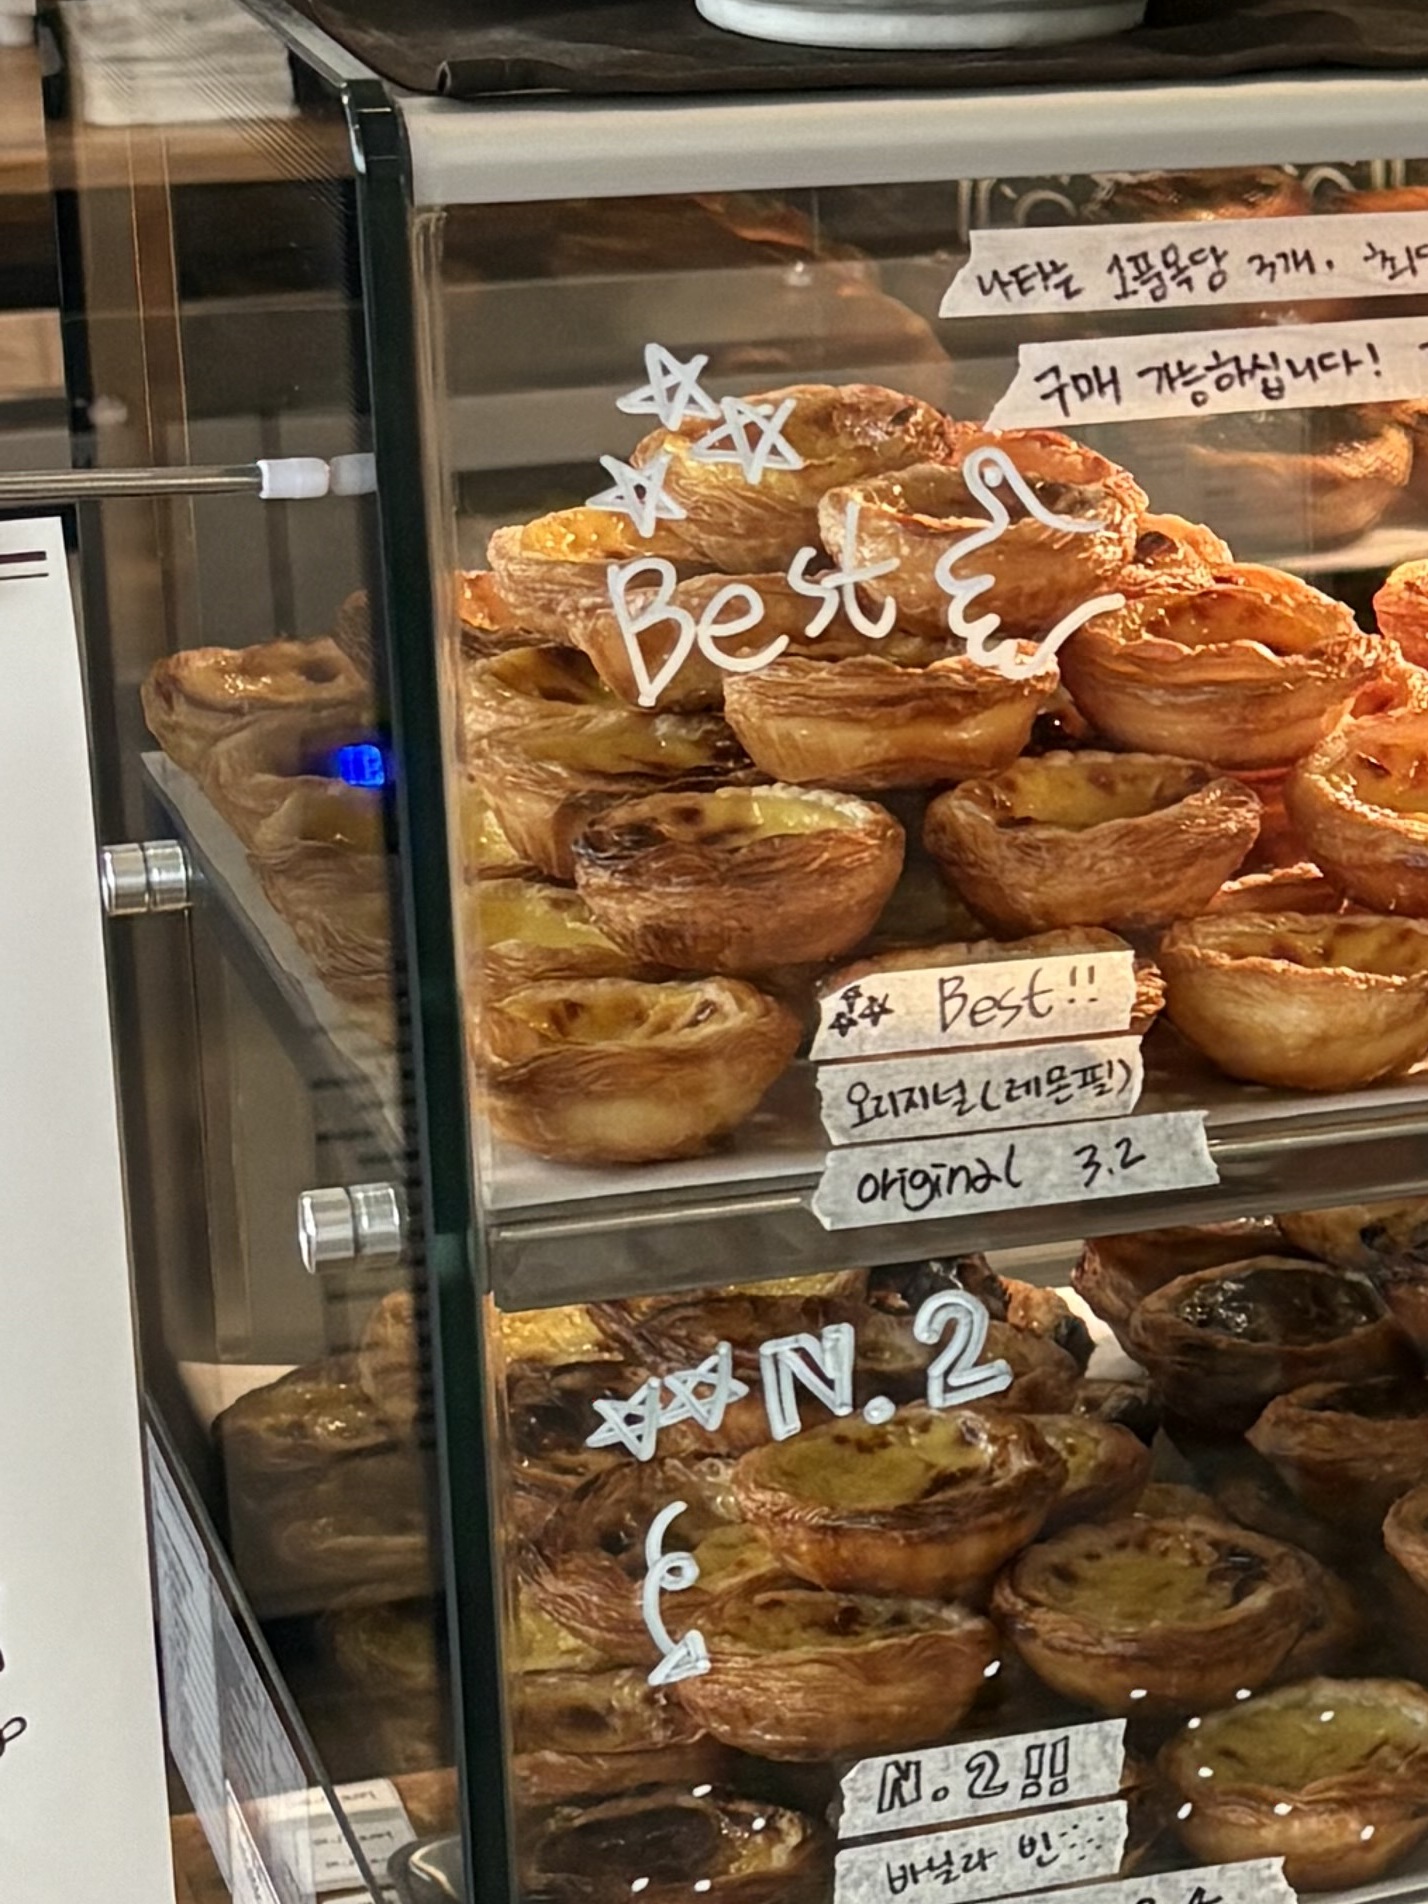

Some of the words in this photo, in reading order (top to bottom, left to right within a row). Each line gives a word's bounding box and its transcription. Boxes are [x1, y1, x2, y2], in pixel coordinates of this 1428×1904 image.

[976, 259, 1085, 301] 나타는
[1107, 243, 1229, 302] 1품목당
[1034, 364, 1122, 417] 구매
[1136, 342, 1381, 407] 가능하십니다!
[606, 500, 901, 708] Best
[1074, 1137, 1147, 1188] 3.2
[885, 1848, 998, 1895] 바닐라
[1018, 1830, 1059, 1869] 빈
